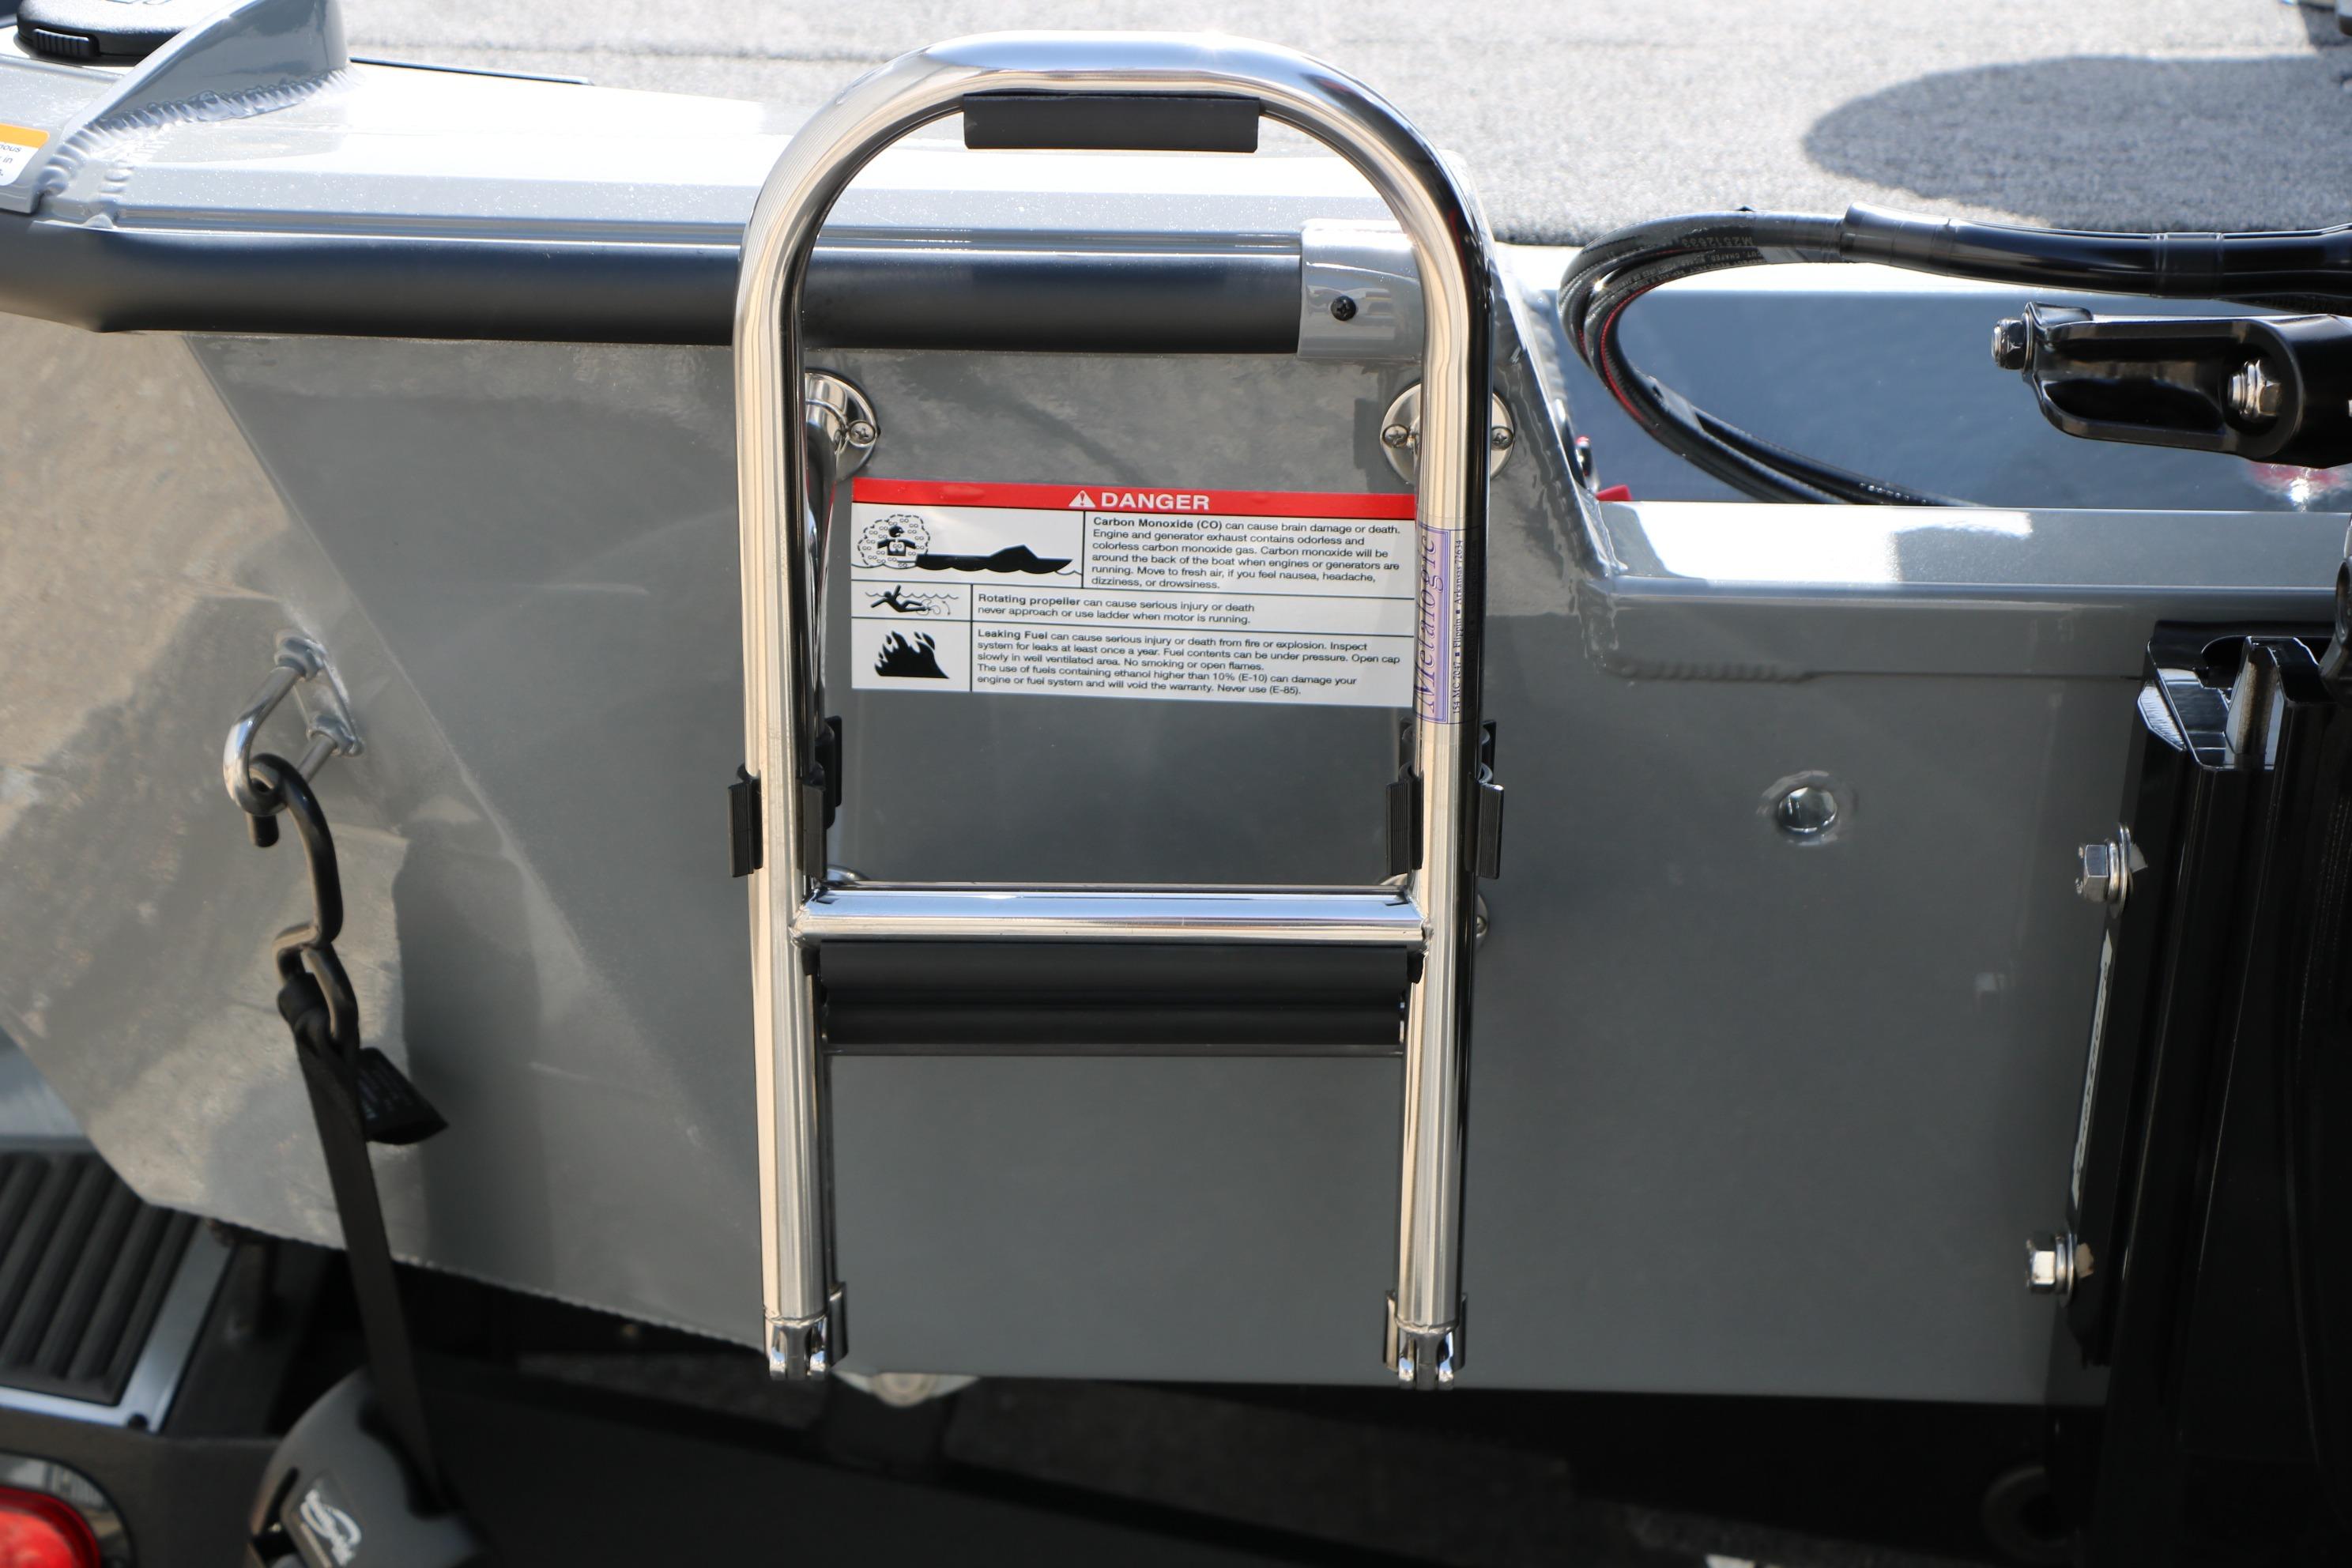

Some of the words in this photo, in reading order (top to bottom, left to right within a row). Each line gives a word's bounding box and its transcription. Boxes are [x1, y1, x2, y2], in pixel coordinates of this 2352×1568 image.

[1101, 492, 1209, 511] DANGER
[1092, 516, 1135, 526] Carbon
[1137, 518, 1194, 528] Monoxide
[1196, 519, 1223, 530] (CO)
[1280, 522, 1307, 531] brain
[1309, 523, 1352, 534] damage
[1367, 525, 1401, 533] death.
[1092, 528, 1129, 540] Engine
[1131, 530, 1152, 539] and
[1153, 531, 1204, 542] generator
[1206, 532, 1247, 541] exhaust
[1250, 533, 1295, 543] contains
[1297, 535, 1342, 545] odorless
[1344, 537, 1364, 545] and
[1091, 541, 1140, 550] colorless
[1140, 542, 1179, 552] carbon
[1180, 544, 1233, 553] monoxide
[1234, 547, 1259, 556] gas.
[1258, 545, 1299, 556] Carbon
[1300, 547, 1354, 556] monoxide
[1354, 548, 1373, 557] will
[1374, 548, 1389, 557] be
[1455, 540, 1464, 564] 72634
[1091, 553, 1129, 562] around
[1130, 554, 1148, 563] the
[1150, 555, 1177, 564] back
[1178, 555, 1190, 564] of
[1191, 556, 1209, 564] the
[1211, 556, 1235, 565] boat
[1237, 557, 1266, 567] when
[1268, 558, 1310, 569] engines
[1325, 560, 1381, 571] generators
[1091, 564, 1134, 575] running.
[1136, 566, 1166, 575] Move
[1179, 567, 1208, 576] fresh
[1208, 568, 1225, 578] air,
[1235, 571, 1256, 579] you
[1257, 570, 1276, 579] feel
[1278, 572, 1320, 581] nausea,
[1321, 571, 1376, 582] headache,
[1091, 576, 1142, 586] dizziness,
[1158, 579, 1219, 588] drowsiness.
[978, 593, 1027, 605] Rotating
[1028, 595, 1081, 608] propeller
[1139, 600, 1178, 609] serious
[1179, 601, 1209, 612] injury
[1224, 602, 1255, 612] death
[1008, 607, 1058, 617] approach
[1095, 609, 1130, 619] ladder
[1132, 611, 1161, 620] when
[1163, 612, 1195, 621] motor
[1196, 613, 1206, 622] is
[1208, 613, 1251, 625] running.
[1414, 535, 1444, 714] Metalogic
[977, 628, 1021, 640] Leaking
[1023, 630, 1048, 639] Fuel
[1105, 634, 1142, 643] serious
[1144, 635, 1172, 646] injury
[1187, 637, 1216, 646] death
[1218, 638, 1242, 646] from
[1244, 639, 1261, 647] fire
[1275, 640, 1327, 651] explosion.
[1329, 642, 1367, 652] Inspect
[1453, 617, 1464, 648] Flippin
[978, 641, 1012, 650] system
[1032, 643, 1058, 651] leaks
[1073, 644, 1097, 653] least
[1137, 648, 1160, 657] year.
[1163, 647, 1184, 656] Fuel
[1186, 649, 1231, 658] contents
[1270, 650, 1298, 660] under
[1302, 654, 1348, 663] pressure.
[1351, 654, 1378, 664] Open
[978, 652, 1008, 662] slowly
[1046, 654, 1094, 664] ventilated
[1140, 658, 1184, 669] smoking
[1228, 661, 1264, 670] flames.
[1032, 665, 1056, 674] fuels
[1058, 666, 1111, 678] containing
[1114, 669, 1151, 677] ethanol
[1153, 670, 1185, 680] higher
[1187, 671, 1209, 680] than
[1213, 672, 1234, 680] 10%
[1238, 673, 1268, 683] (E-10)
[1291, 675, 1332, 685] damage
[1335, 677, 1356, 686] your
[977, 676, 1011, 685] engine
[1026, 676, 1045, 684] fuel
[1047, 678, 1083, 688] system
[1085, 679, 1105, 688] and
[1169, 682, 1215, 692] warranty.
[1216, 684, 1246, 692] Never
[1268, 685, 1301, 695] (E-85).
[1453, 682, 1461, 698] MC
